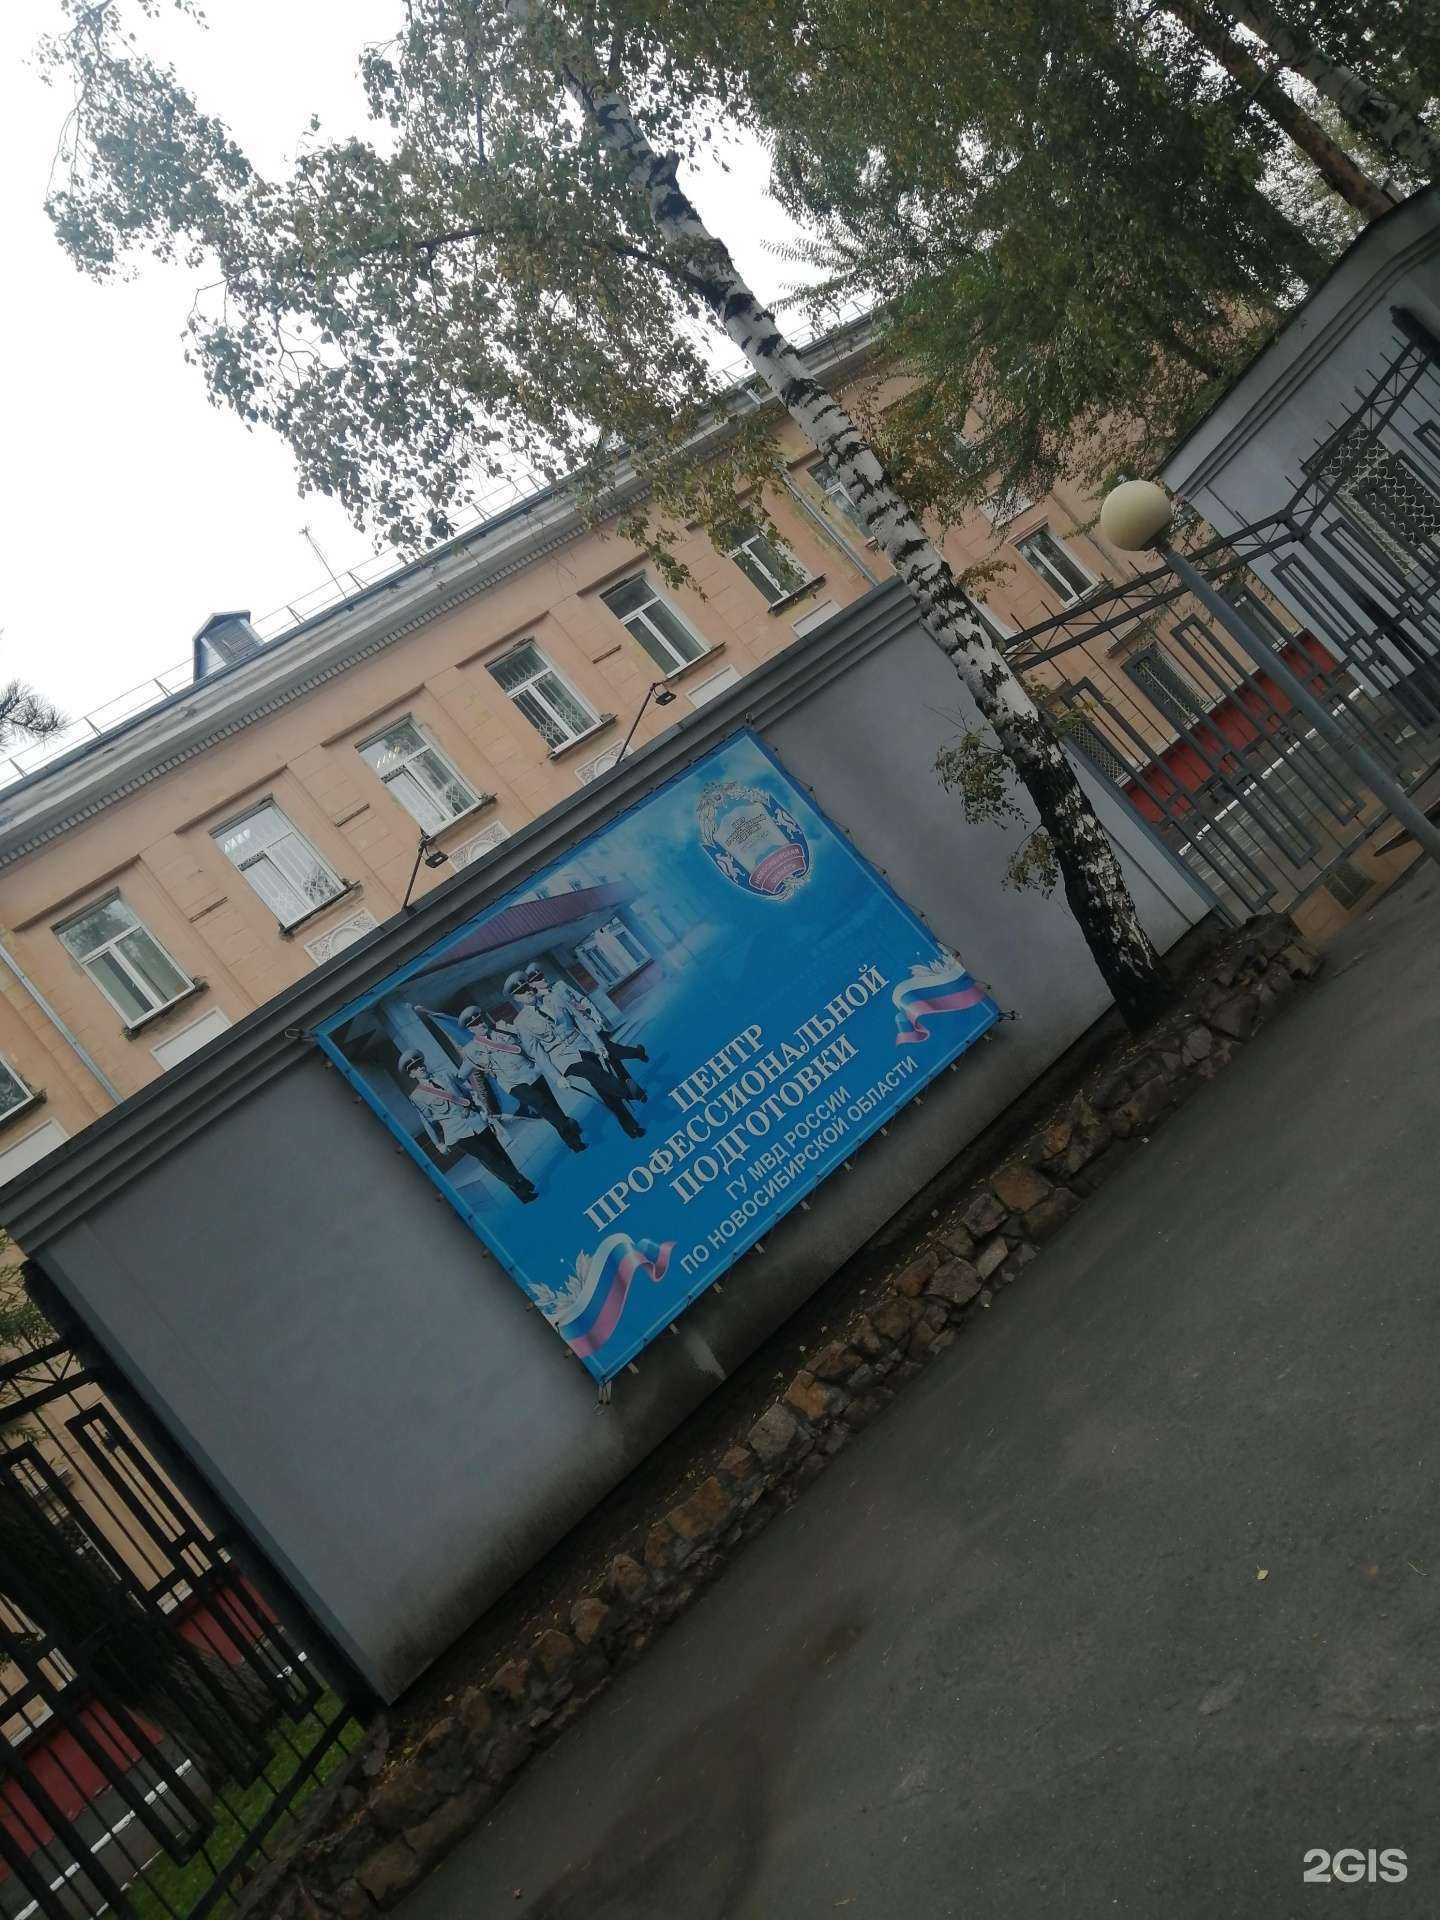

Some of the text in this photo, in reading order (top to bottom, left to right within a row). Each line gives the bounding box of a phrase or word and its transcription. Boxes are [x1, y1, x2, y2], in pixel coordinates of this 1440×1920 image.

[583, 963, 890, 1232] ПРОФЕССИОНАЛЬНОЙ
[668, 1023, 763, 1113] ЦЕНТР
[669, 1033, 860, 1205] ПОДГОТОВКИ
[725, 1085, 852, 1201] ГУ МВД РОССИИ
[679, 1055, 919, 1275] ПО НОВОСИБИРСКОЙ ОБЛАСТИ
